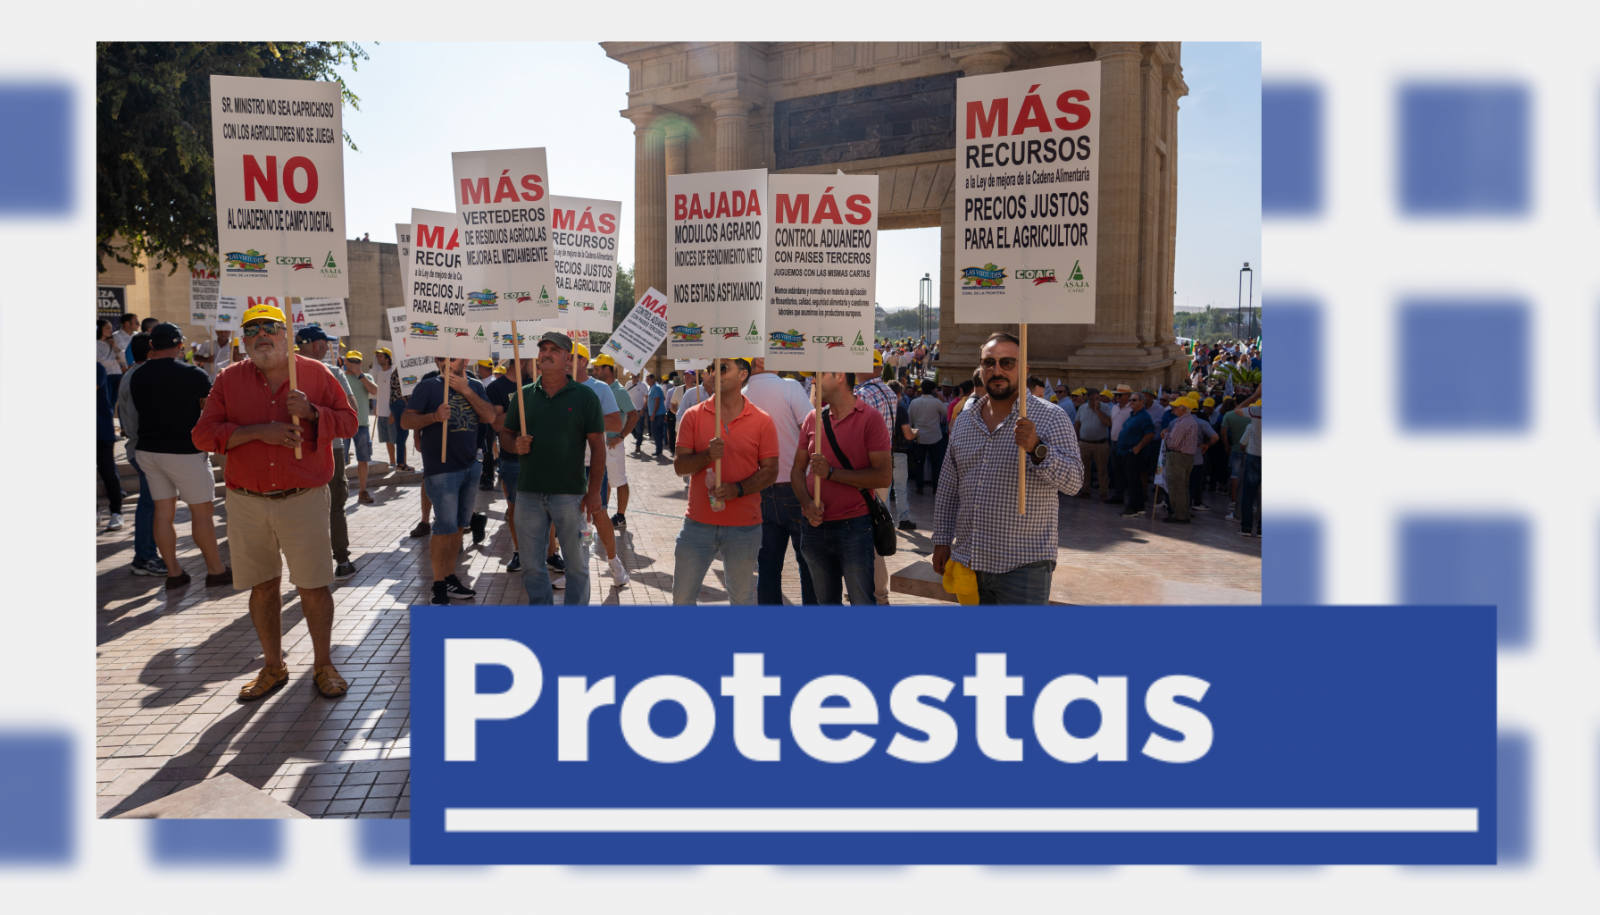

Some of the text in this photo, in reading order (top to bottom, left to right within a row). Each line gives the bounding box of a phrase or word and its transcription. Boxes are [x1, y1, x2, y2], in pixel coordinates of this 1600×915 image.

[222, 96, 334, 118] SR. MINISTRO NO SEA CAPRICHOSO
[966, 84, 1091, 140] MÁS
[223, 123, 335, 144] CON LOS AGRICULTORES NO SE JUEGA
[966, 135, 1090, 169] RECURSOS
[243, 154, 318, 204] NO
[461, 169, 544, 205] MÁS
[966, 167, 1090, 191] a la Ley de mejora de la Cadena Alimentaria
[463, 207, 545, 225] VERTEDEROS
[675, 189, 761, 221] BAJADA
[776, 186, 872, 225] MÁS
[965, 191, 1089, 221] PRECIOS JUSTOS
[228, 208, 334, 232] AL CUADERNO DE CAMPO DIGITAL
[552, 206, 615, 234] MÁS
[465, 223, 546, 245] DE RESIDUOS AGRÍCOLAS
[553, 232, 614, 250] RECURSOS
[675, 220, 761, 244] MÓDULOS AGRARIO
[776, 228, 871, 248] CONTROL ADUANERO
[965, 223, 1088, 250] PARA EL AGRICULTOR
[416, 250, 461, 268] RECUR
[467, 247, 548, 266] MEJORA EL MEDIAMBIENTE
[675, 247, 762, 267] ÍNDICES DE RENDIMIENTO NETO
[775, 251, 871, 264] CON PAISES TERCEROS
[555, 260, 612, 278] RECIOS JUSTOS
[976, 270, 1002, 278] VIRTUDES
[1015, 269, 1055, 279] COAG
[414, 282, 453, 298] PRECIOS
[565, 277, 572, 290] EL
[573, 278, 611, 293] AGRICULTOR
[674, 281, 763, 303] NOS ESTAIS ASFIXIANDO!
[413, 299, 465, 316] PARA EL AGRIC
